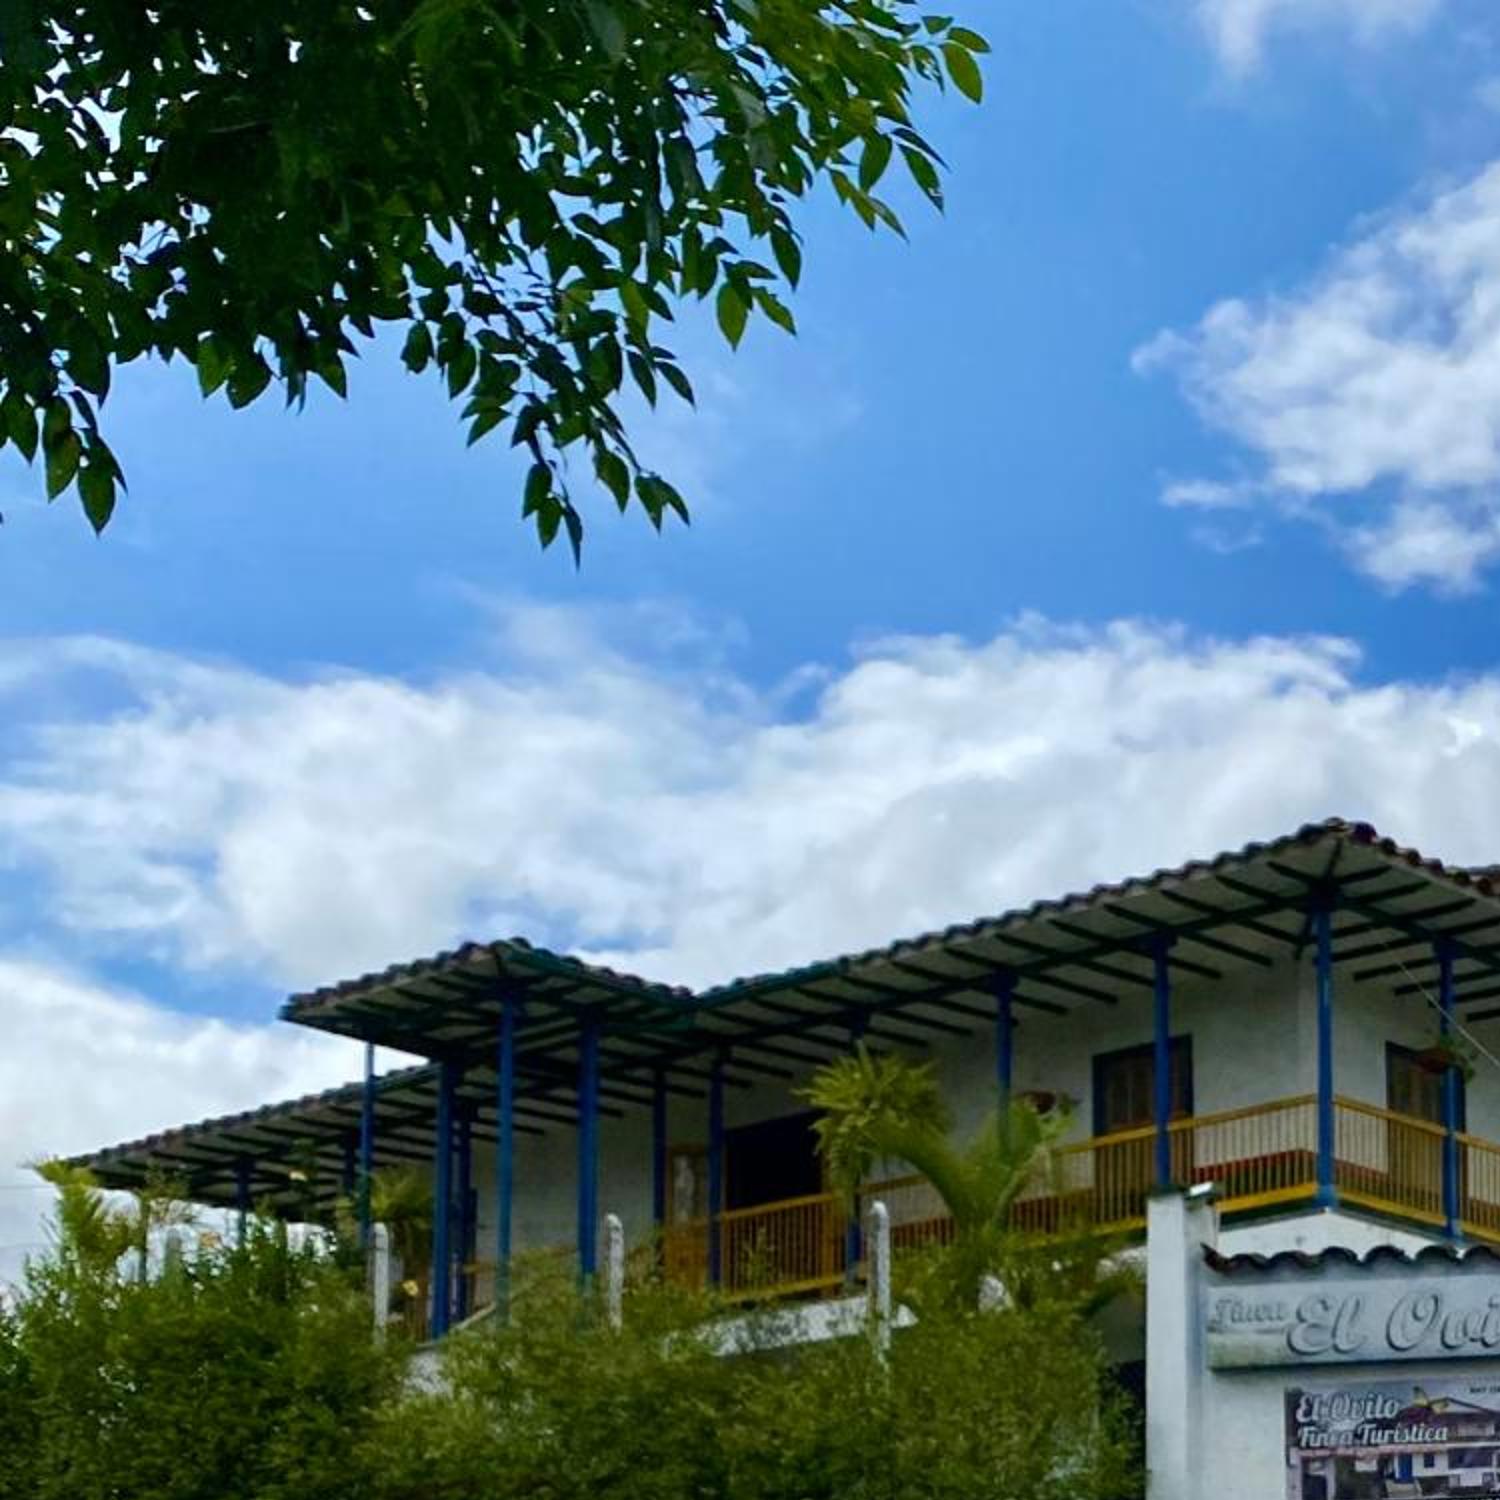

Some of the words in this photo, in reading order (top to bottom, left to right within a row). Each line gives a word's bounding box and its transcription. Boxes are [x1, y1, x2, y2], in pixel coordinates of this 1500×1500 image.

[1286, 1296, 1364, 1355] El
[1296, 1393, 1322, 1422] El
[1325, 1392, 1400, 1423] Ovito
[1299, 1425, 1355, 1447] Finca
[1356, 1422, 1449, 1444] Turística
